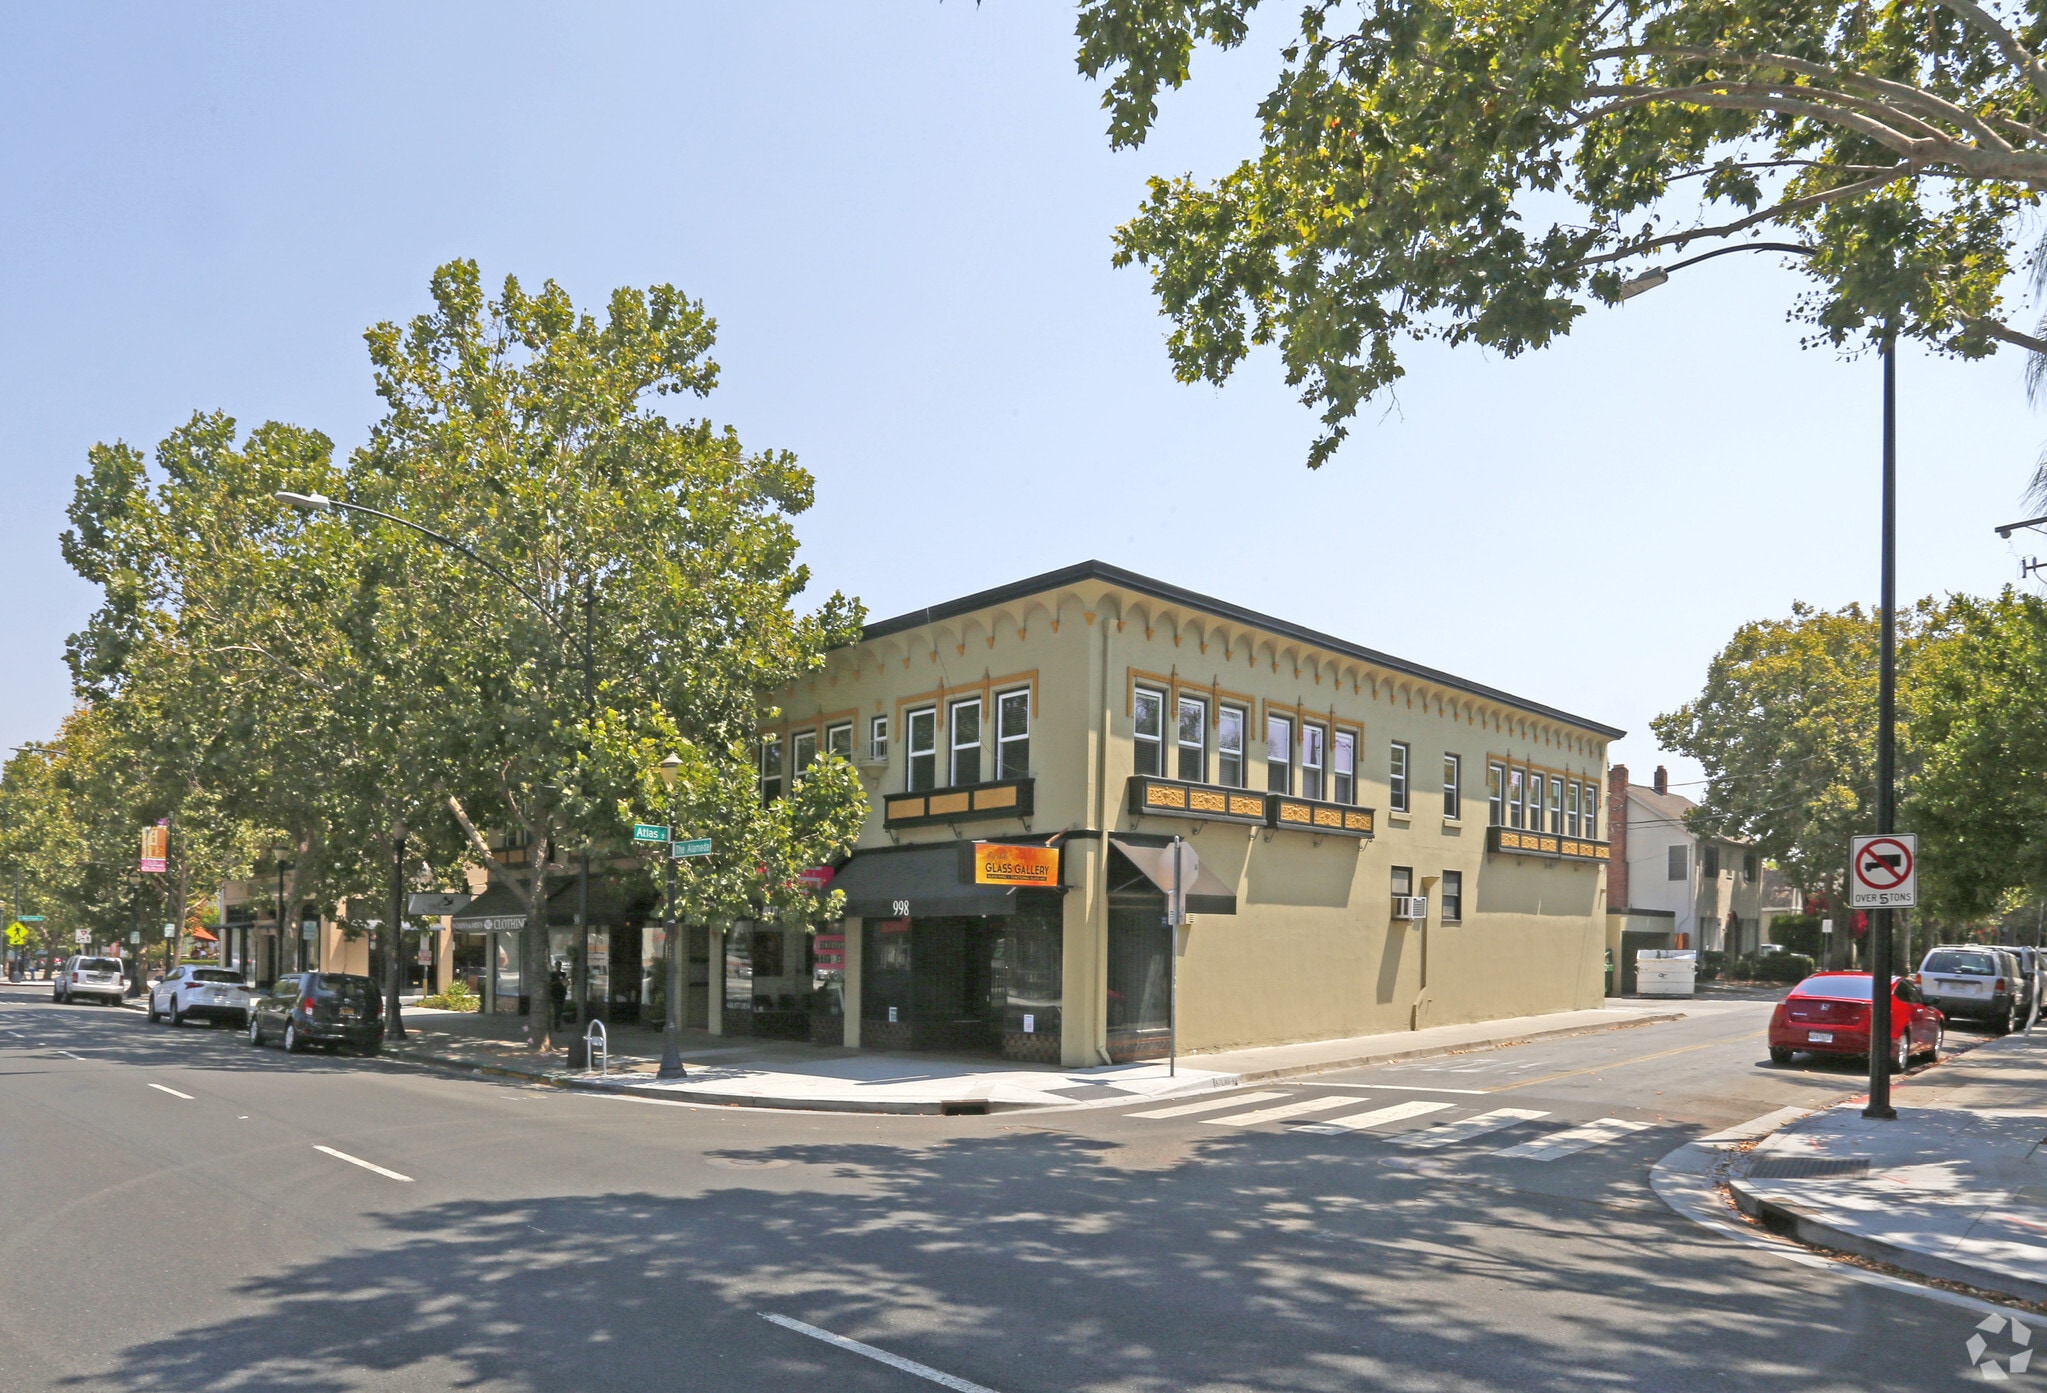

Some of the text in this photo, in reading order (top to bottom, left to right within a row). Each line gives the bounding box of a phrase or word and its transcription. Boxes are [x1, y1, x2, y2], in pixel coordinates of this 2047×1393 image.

[636, 828, 659, 839] Atlas
[676, 842, 710, 855] The Alameda
[985, 862, 1049, 875] GLASS GALLERY
[1855, 892, 1911, 904] OVER 5 TONS
[893, 900, 909, 916] 998
